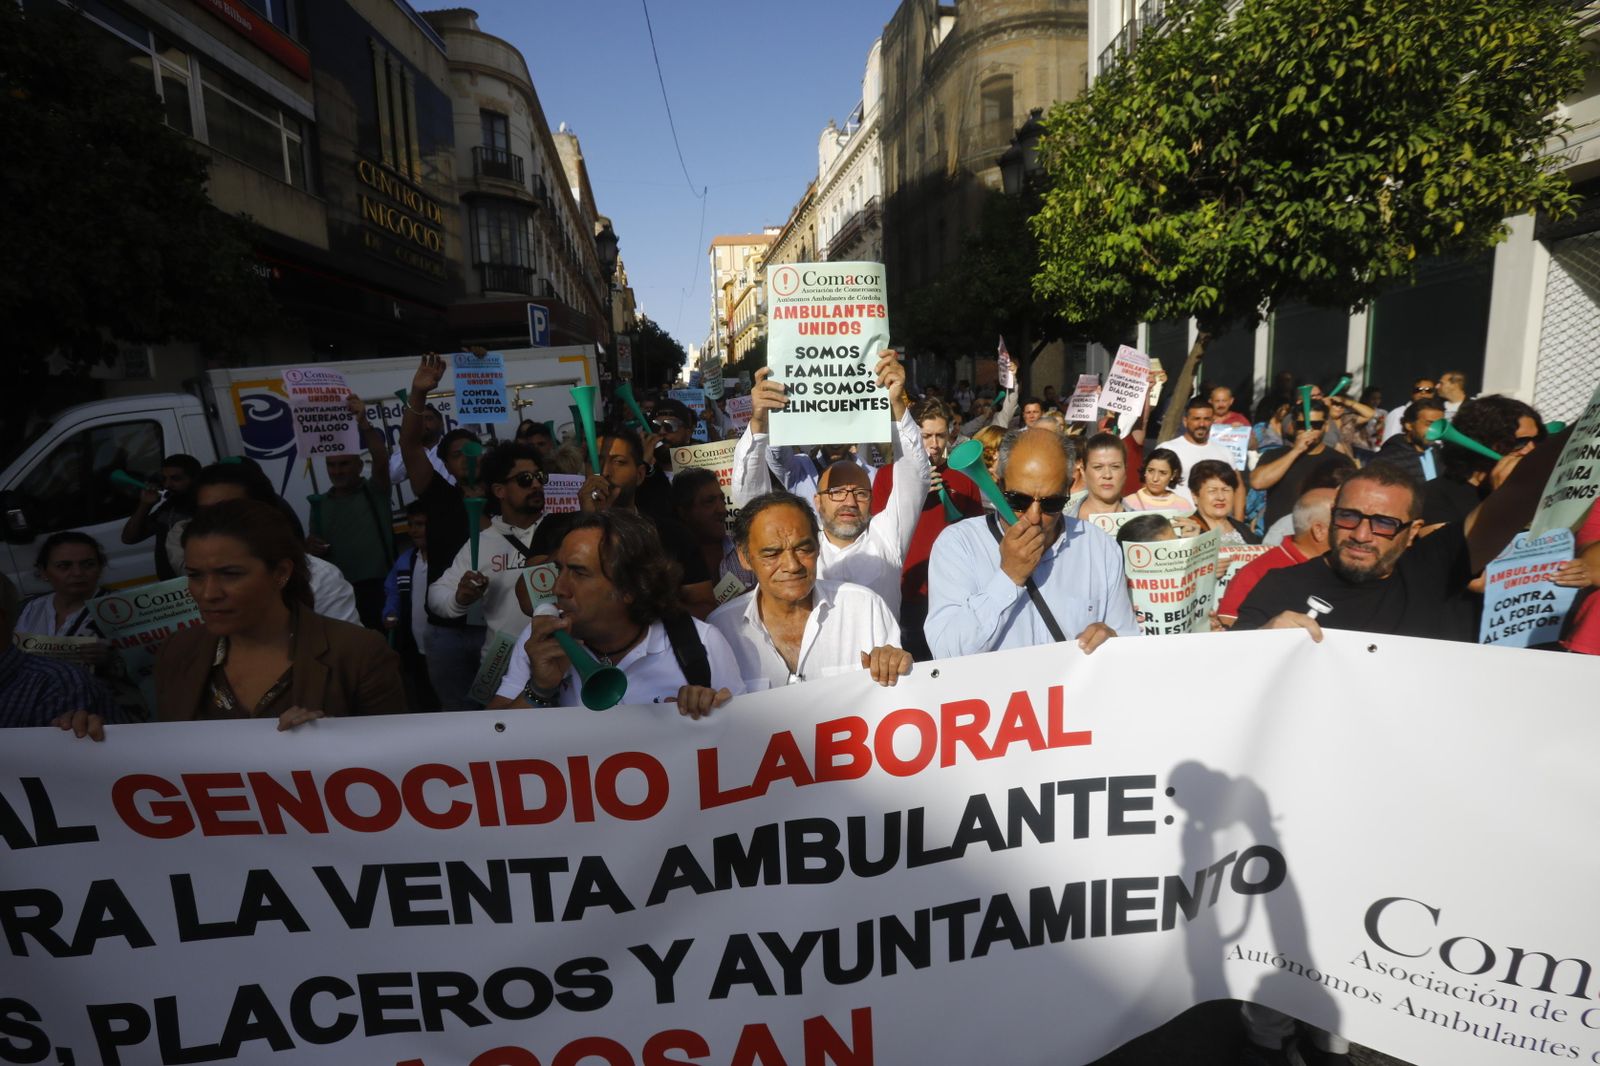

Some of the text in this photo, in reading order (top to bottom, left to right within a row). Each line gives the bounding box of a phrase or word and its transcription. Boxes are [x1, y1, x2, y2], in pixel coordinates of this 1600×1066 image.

[359, 160, 424, 214] CENTRO
[803, 271, 880, 286] Comacor
[773, 304, 886, 319] AMBULANTES
[533, 309, 546, 342] P
[798, 320, 862, 336] UNIDOS
[795, 345, 860, 360] SOMOS
[785, 362, 872, 378] FAMILIAS,
[783, 380, 877, 395] NO SOMOS
[1109, 379, 1145, 393] QUEREMOS
[438, 401, 451, 411] de
[472, 406, 506, 414] SECTOR
[1107, 402, 1132, 411] ACOSO
[297, 413, 353, 422] QUEREMOS
[320, 434, 334, 442] NO
[311, 443, 345, 453] ACOSO
[1127, 563, 1215, 590] AMBULANTES
[1149, 582, 1197, 604] UNIDOS
[1494, 590, 1556, 612] CONTRA
[1489, 604, 1555, 628] LA FOBIA
[1145, 626, 1160, 636] NI
[1483, 616, 1560, 644] AL SECTOR
[481, 641, 509, 684] Comacor
[112, 750, 670, 840] GENOCIDIO
[697, 685, 1092, 811] LABORAL
[0, 775, 1176, 958] RA LA VENTA AMBULANTE:
[0, 844, 1287, 1066] S, PLACEROS Y AYUNTAMIENTO
[1364, 896, 1600, 1001] Com
[1349, 949, 1519, 1015] Asociación
[1529, 1000, 1568, 1023] de
[1226, 943, 1580, 1061] Autónomos Ambulantes
